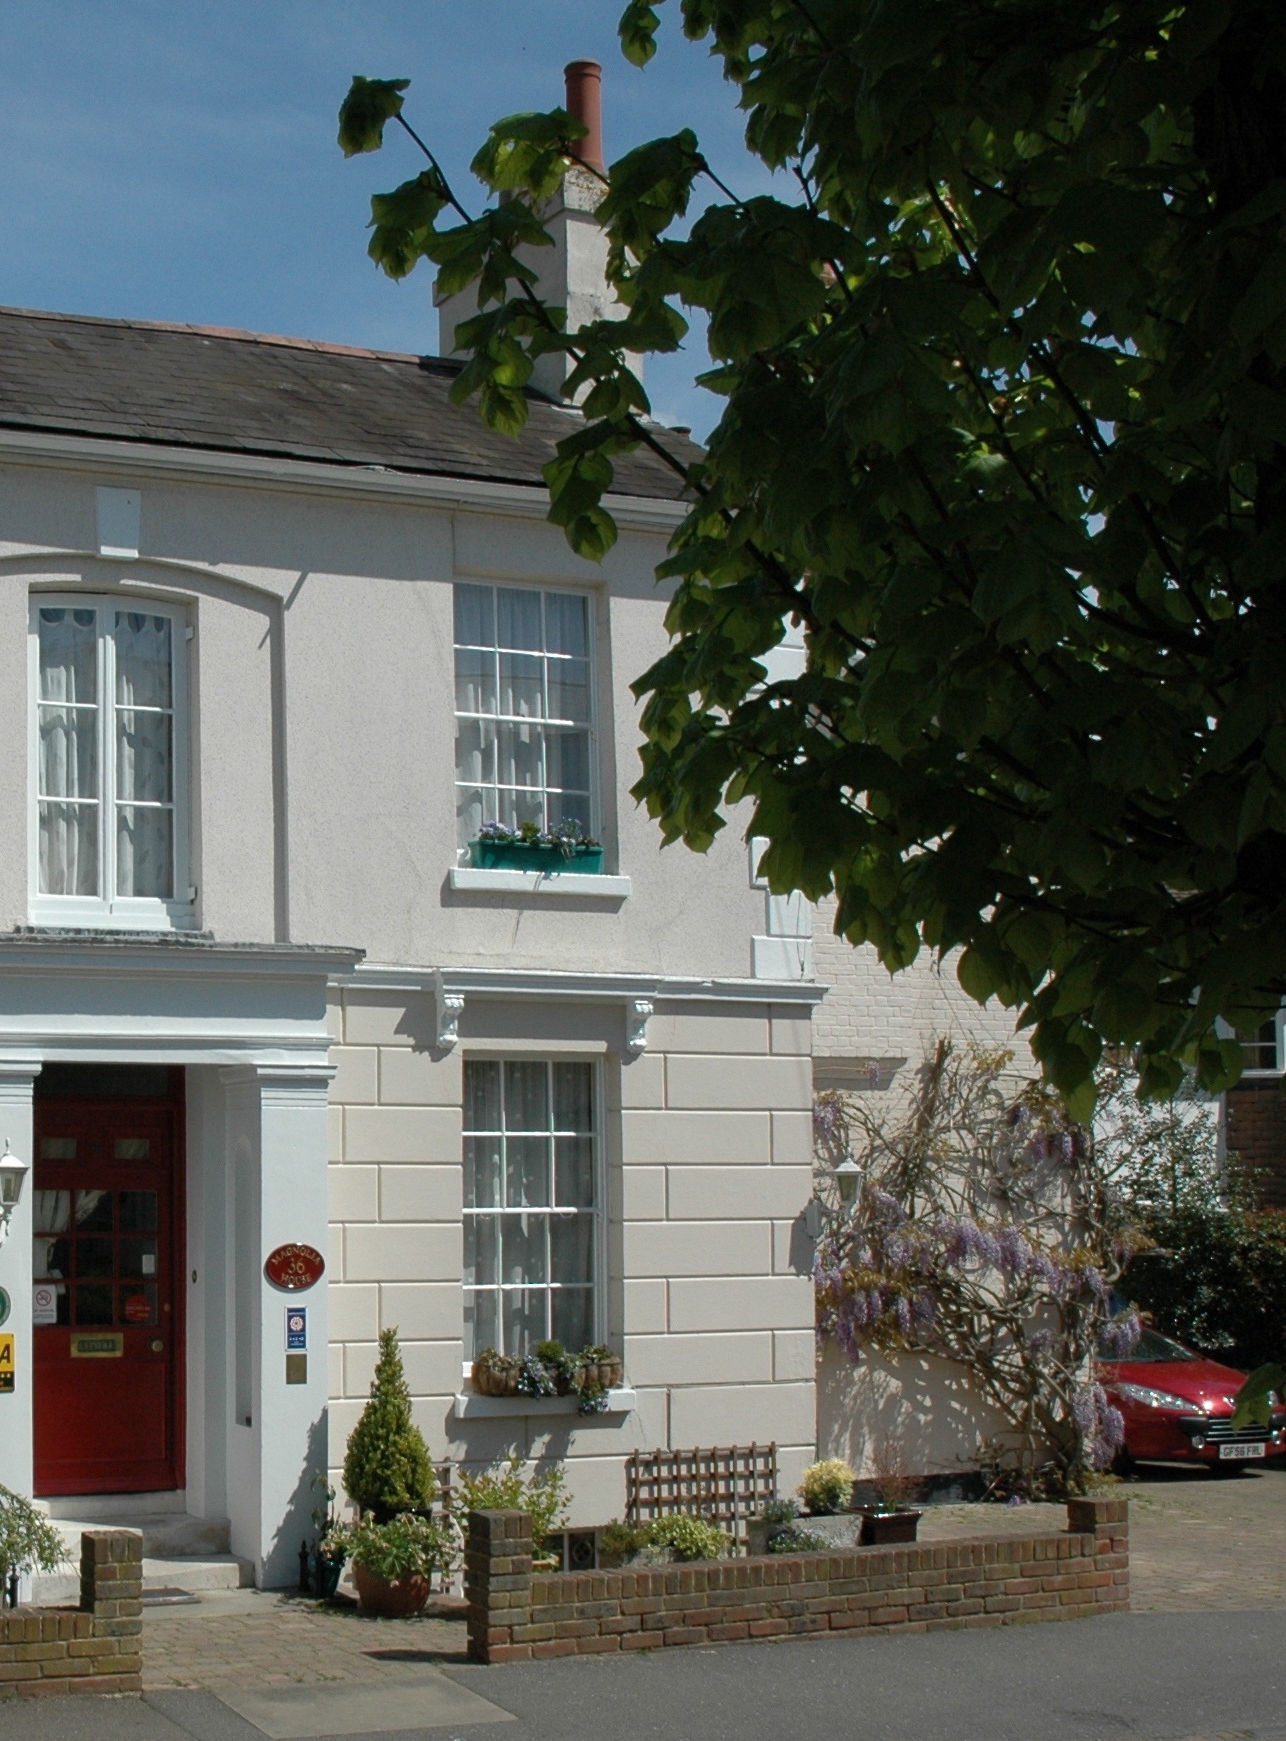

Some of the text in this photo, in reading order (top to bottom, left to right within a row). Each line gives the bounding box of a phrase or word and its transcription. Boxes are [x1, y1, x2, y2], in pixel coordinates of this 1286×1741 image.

[271, 1246, 321, 1265] MAGNOLIA
[287, 1258, 305, 1274] 36
[280, 1273, 311, 1286] HOUSE
